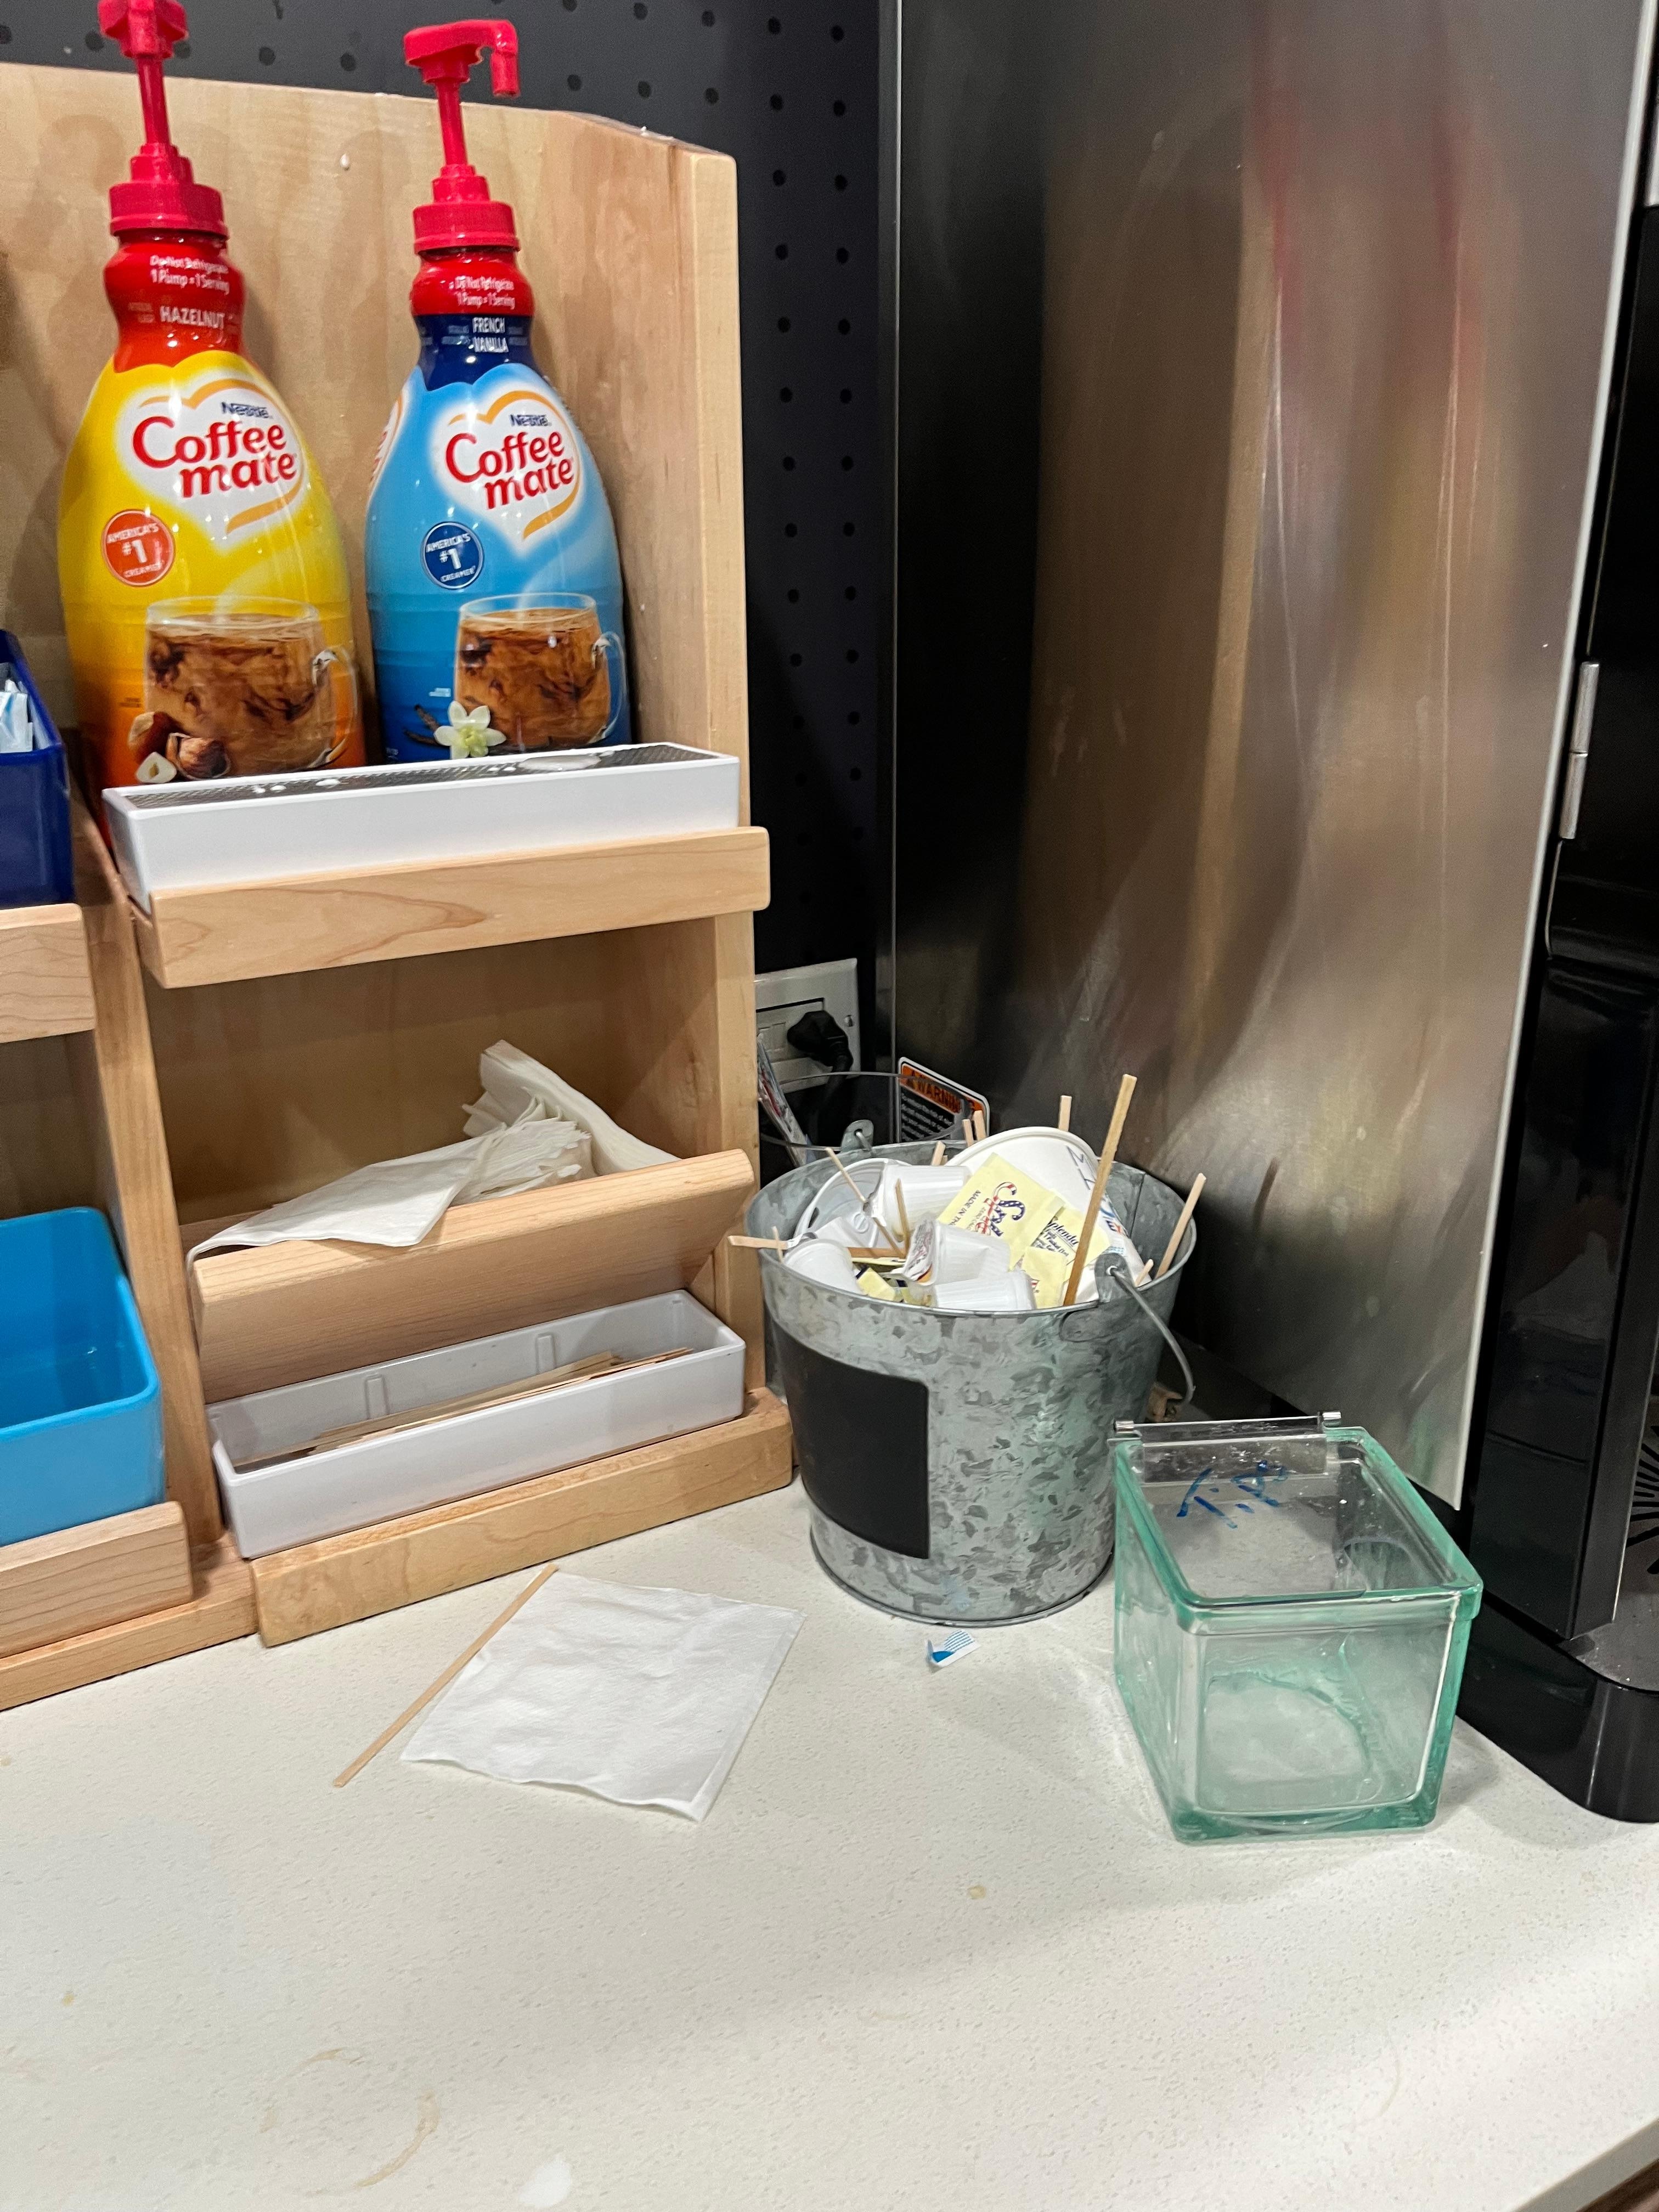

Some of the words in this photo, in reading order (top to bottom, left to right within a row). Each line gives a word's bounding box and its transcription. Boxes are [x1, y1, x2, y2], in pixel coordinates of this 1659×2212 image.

[160, 305, 225, 329] HAZELNUT
[472, 317, 505, 334] FRENCH
[472, 336, 509, 353] VANILLA
[132, 416, 286, 469] Coffee
[445, 432, 565, 483] Coffee
[179, 451, 297, 499] mate
[484, 456, 574, 510] mate
[964, 1189, 981, 1209] MADE
[957, 1207, 968, 1216] IN
[1046, 1221, 1080, 1246] plenda
